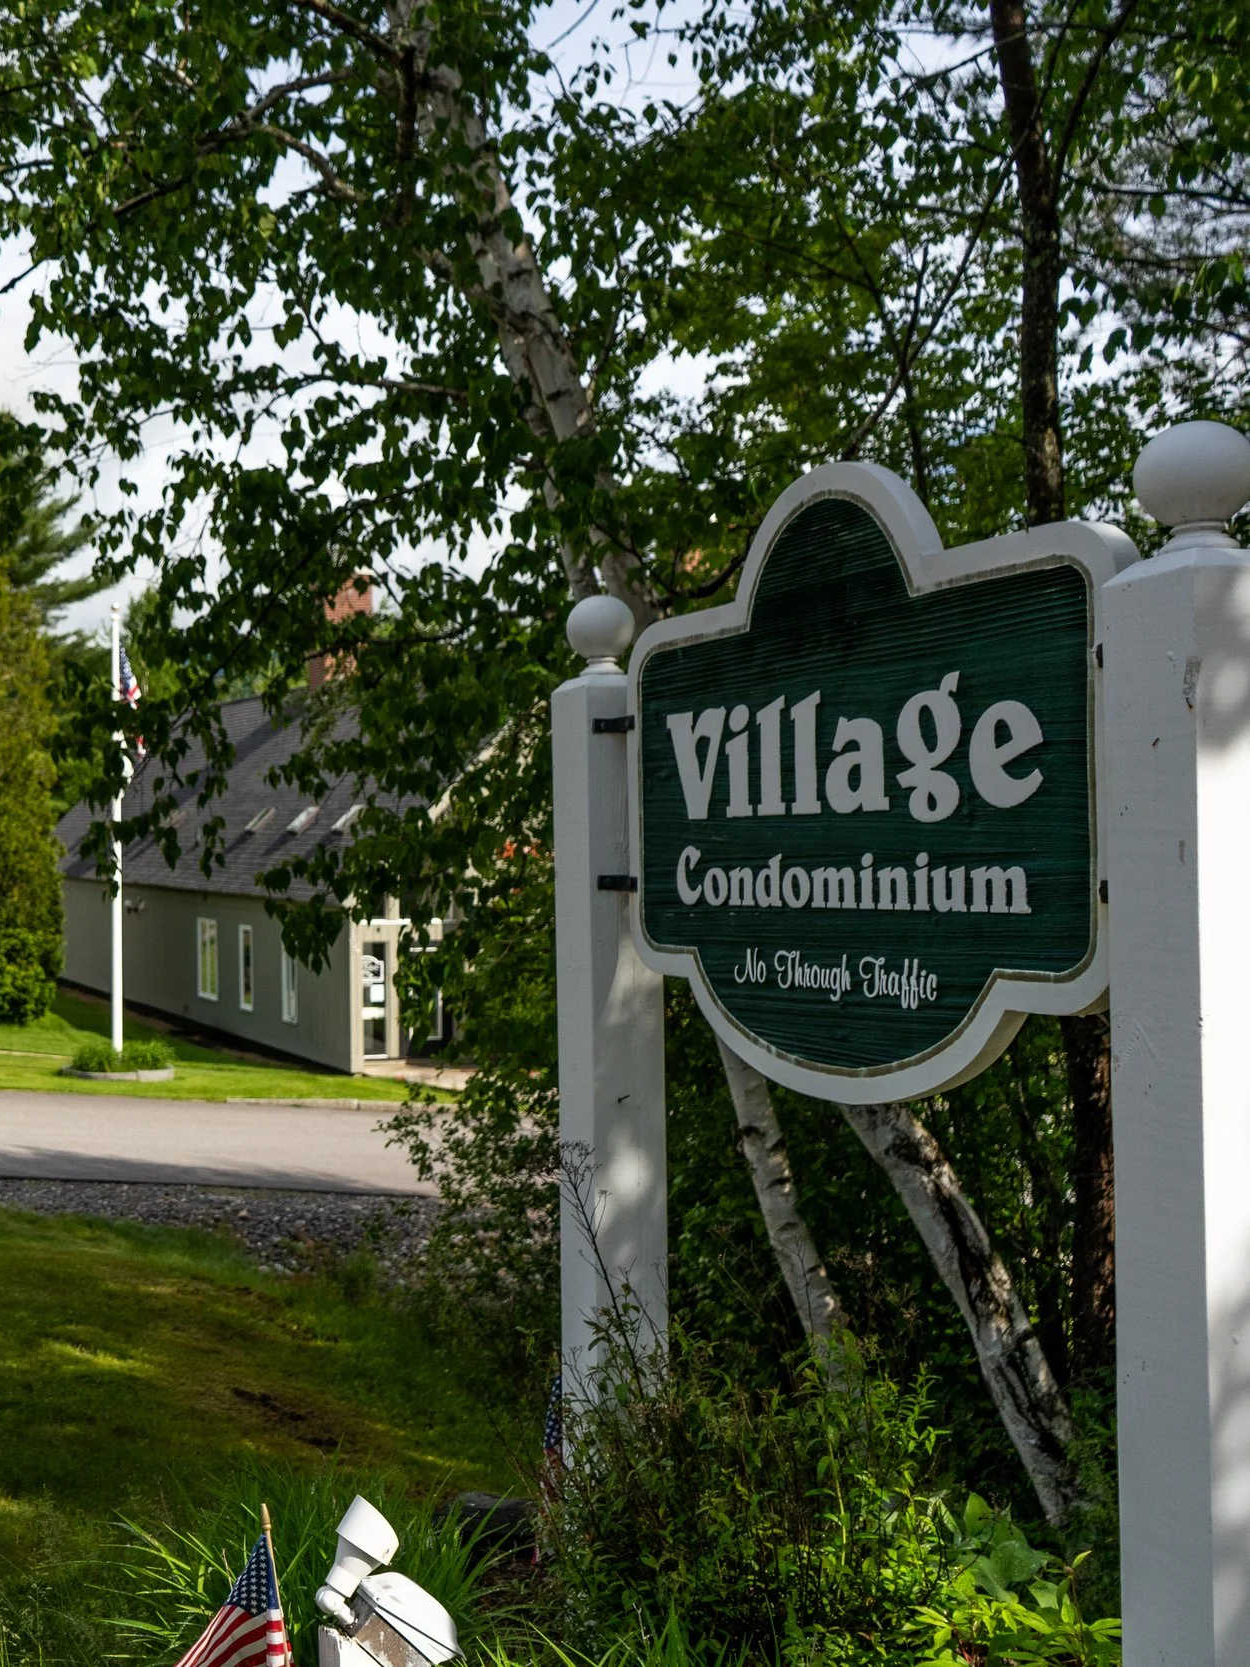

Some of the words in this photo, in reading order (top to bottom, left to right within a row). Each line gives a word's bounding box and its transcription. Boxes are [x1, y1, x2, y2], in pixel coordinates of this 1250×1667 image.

[666, 671, 1044, 823] Village
[676, 845, 1032, 914] Condominium
[734, 948, 766, 983] No
[774, 950, 851, 1001] Through
[859, 956, 937, 1009] Traffic
